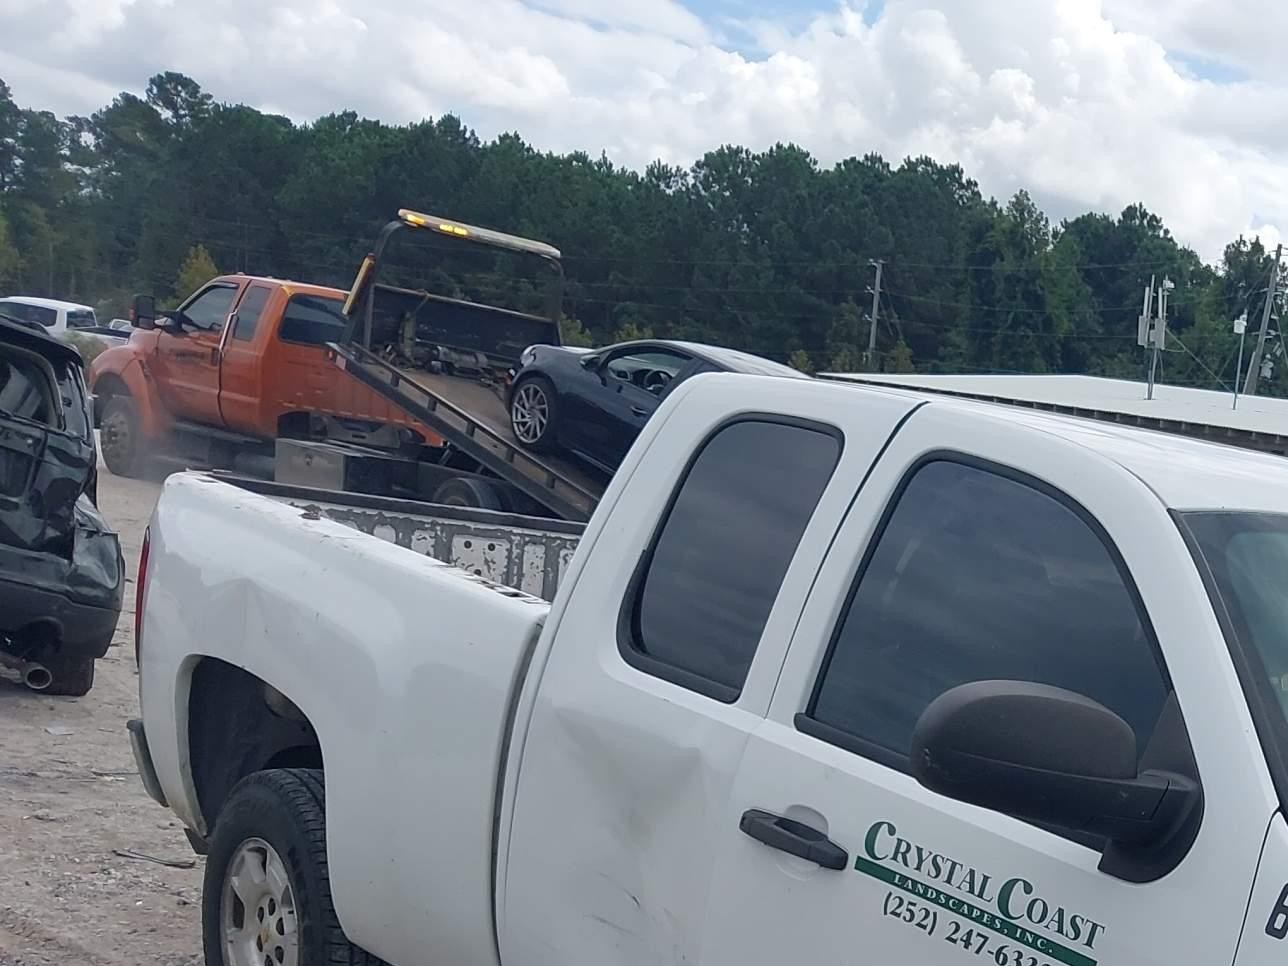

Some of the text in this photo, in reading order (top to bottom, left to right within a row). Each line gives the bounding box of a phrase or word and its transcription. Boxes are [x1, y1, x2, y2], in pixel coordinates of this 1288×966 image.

[883, 891, 938, 936] (252)
[893, 874, 1054, 954] LANDSCAPES, INC.
